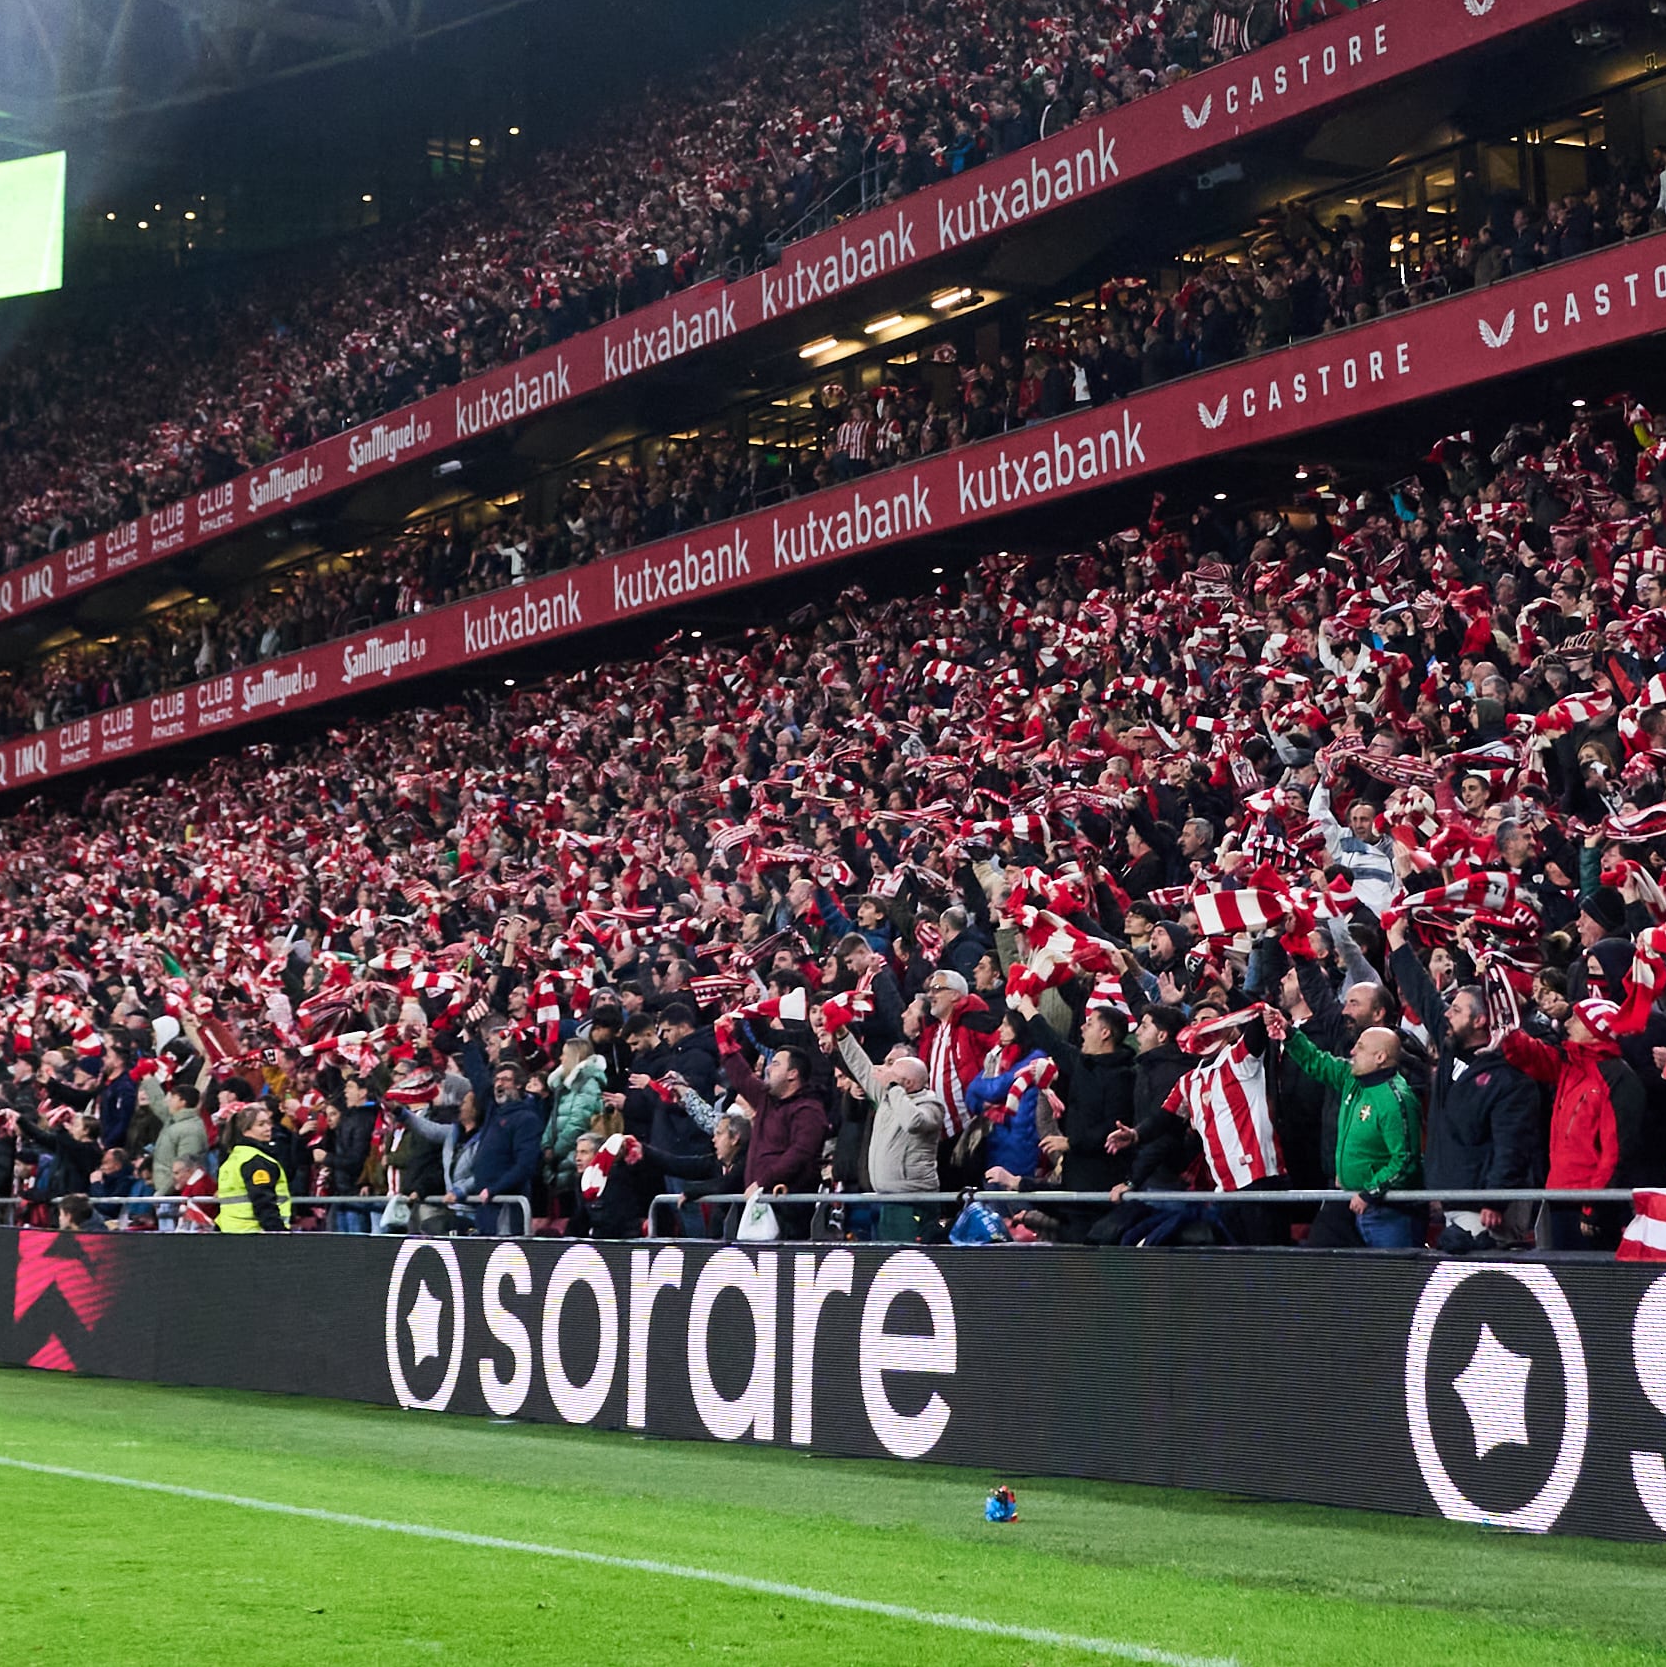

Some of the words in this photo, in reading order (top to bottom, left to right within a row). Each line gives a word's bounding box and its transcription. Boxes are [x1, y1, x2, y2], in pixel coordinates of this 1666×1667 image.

[1225, 24, 1388, 114] CASTORE
[937, 126, 1120, 251] kutxabank
[761, 211, 916, 320] kutxabank
[604, 290, 737, 381] kutxabank
[455, 355, 571, 438] kutxabank
[1242, 341, 1411, 418] CASTORE
[958, 408, 1146, 515] kutxabank
[150, 502, 185, 536] CLUB
[198, 483, 234, 517] CLUB
[773, 475, 932, 568] kutxabank
[65, 540, 95, 571] CLUB
[105, 522, 138, 555] CLUB
[613, 528, 751, 611] kutxabank
[21, 564, 54, 605] IMQ
[464, 579, 582, 655] kutxabank
[101, 707, 133, 737] CLUB
[150, 692, 185, 723] CLUB
[197, 677, 233, 708] CLUB
[15, 740, 48, 777] IMQ
[59, 719, 90, 750] CLUB
[479, 1241, 958, 1460] sorare
